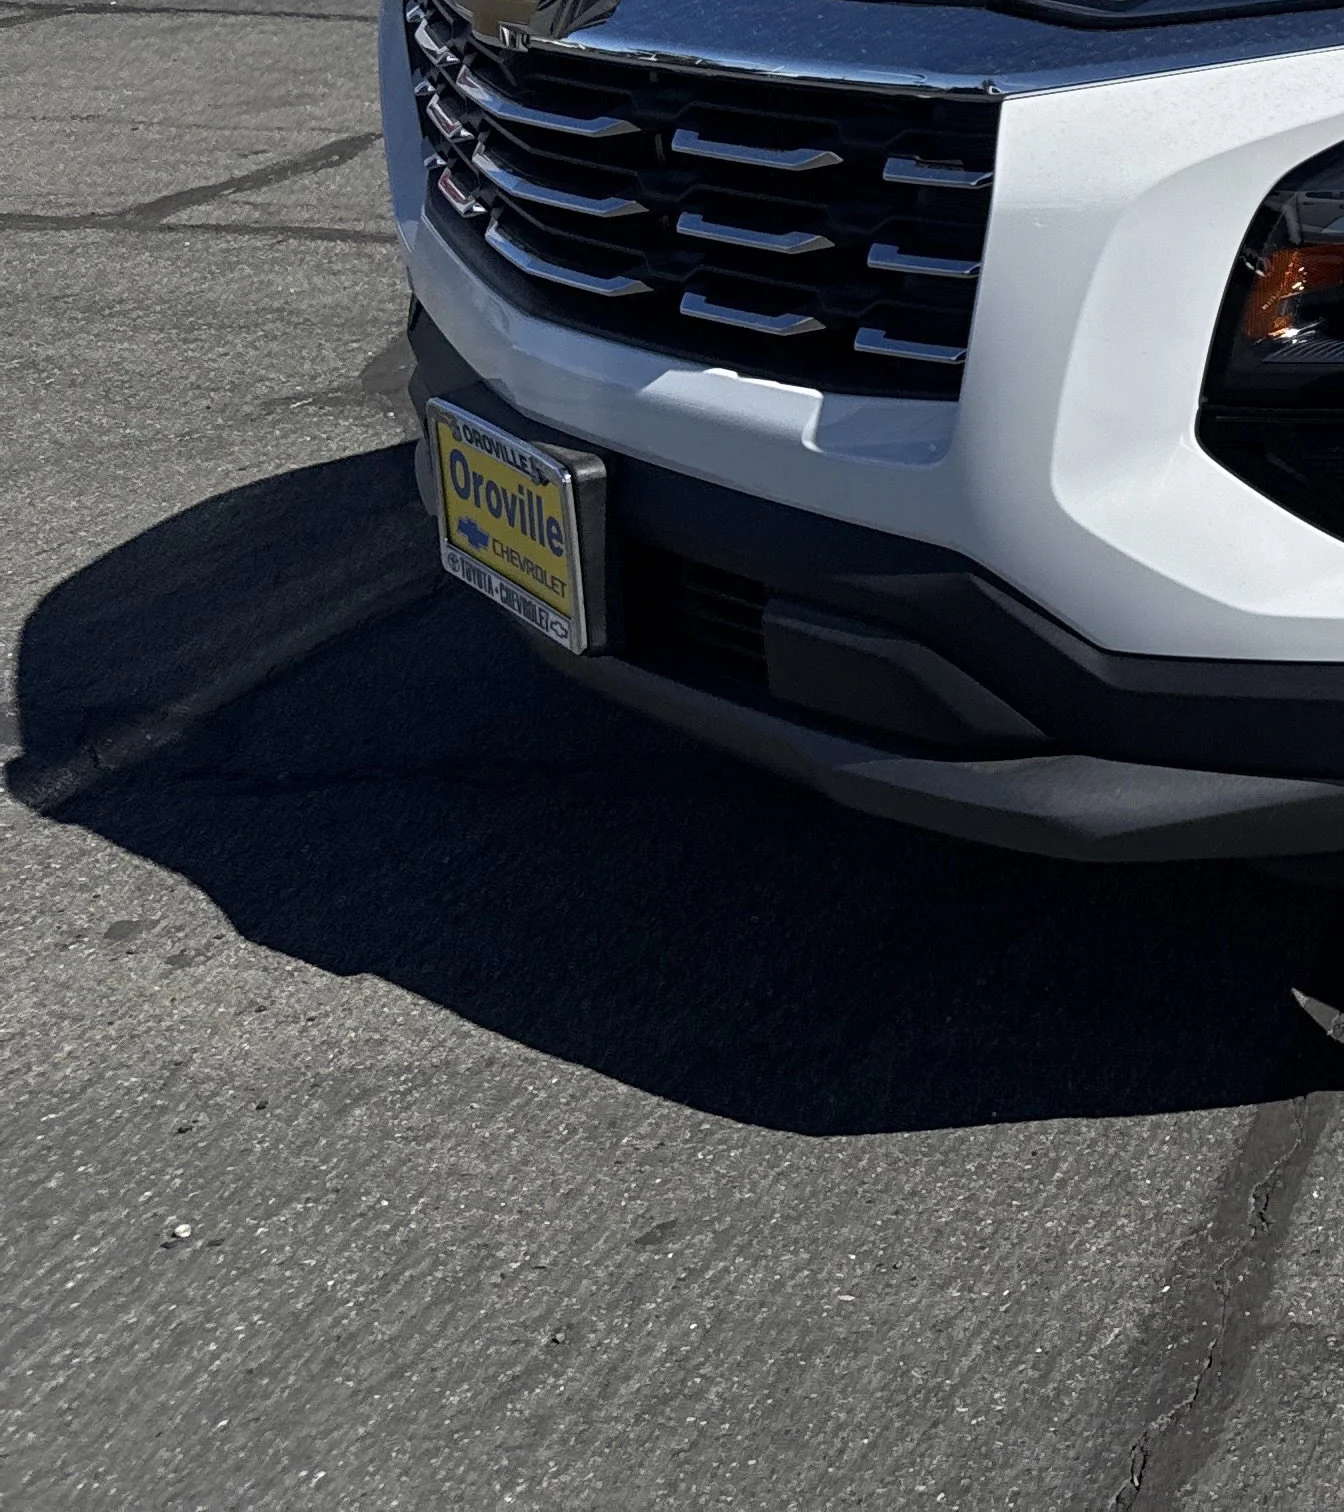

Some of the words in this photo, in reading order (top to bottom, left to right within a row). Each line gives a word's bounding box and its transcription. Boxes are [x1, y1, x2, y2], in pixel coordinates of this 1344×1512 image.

[462, 423, 532, 476] OROVILLE
[449, 448, 564, 558] Oroville
[461, 559, 495, 597] TOYOTA
[492, 538, 567, 598] CHEVROLET
